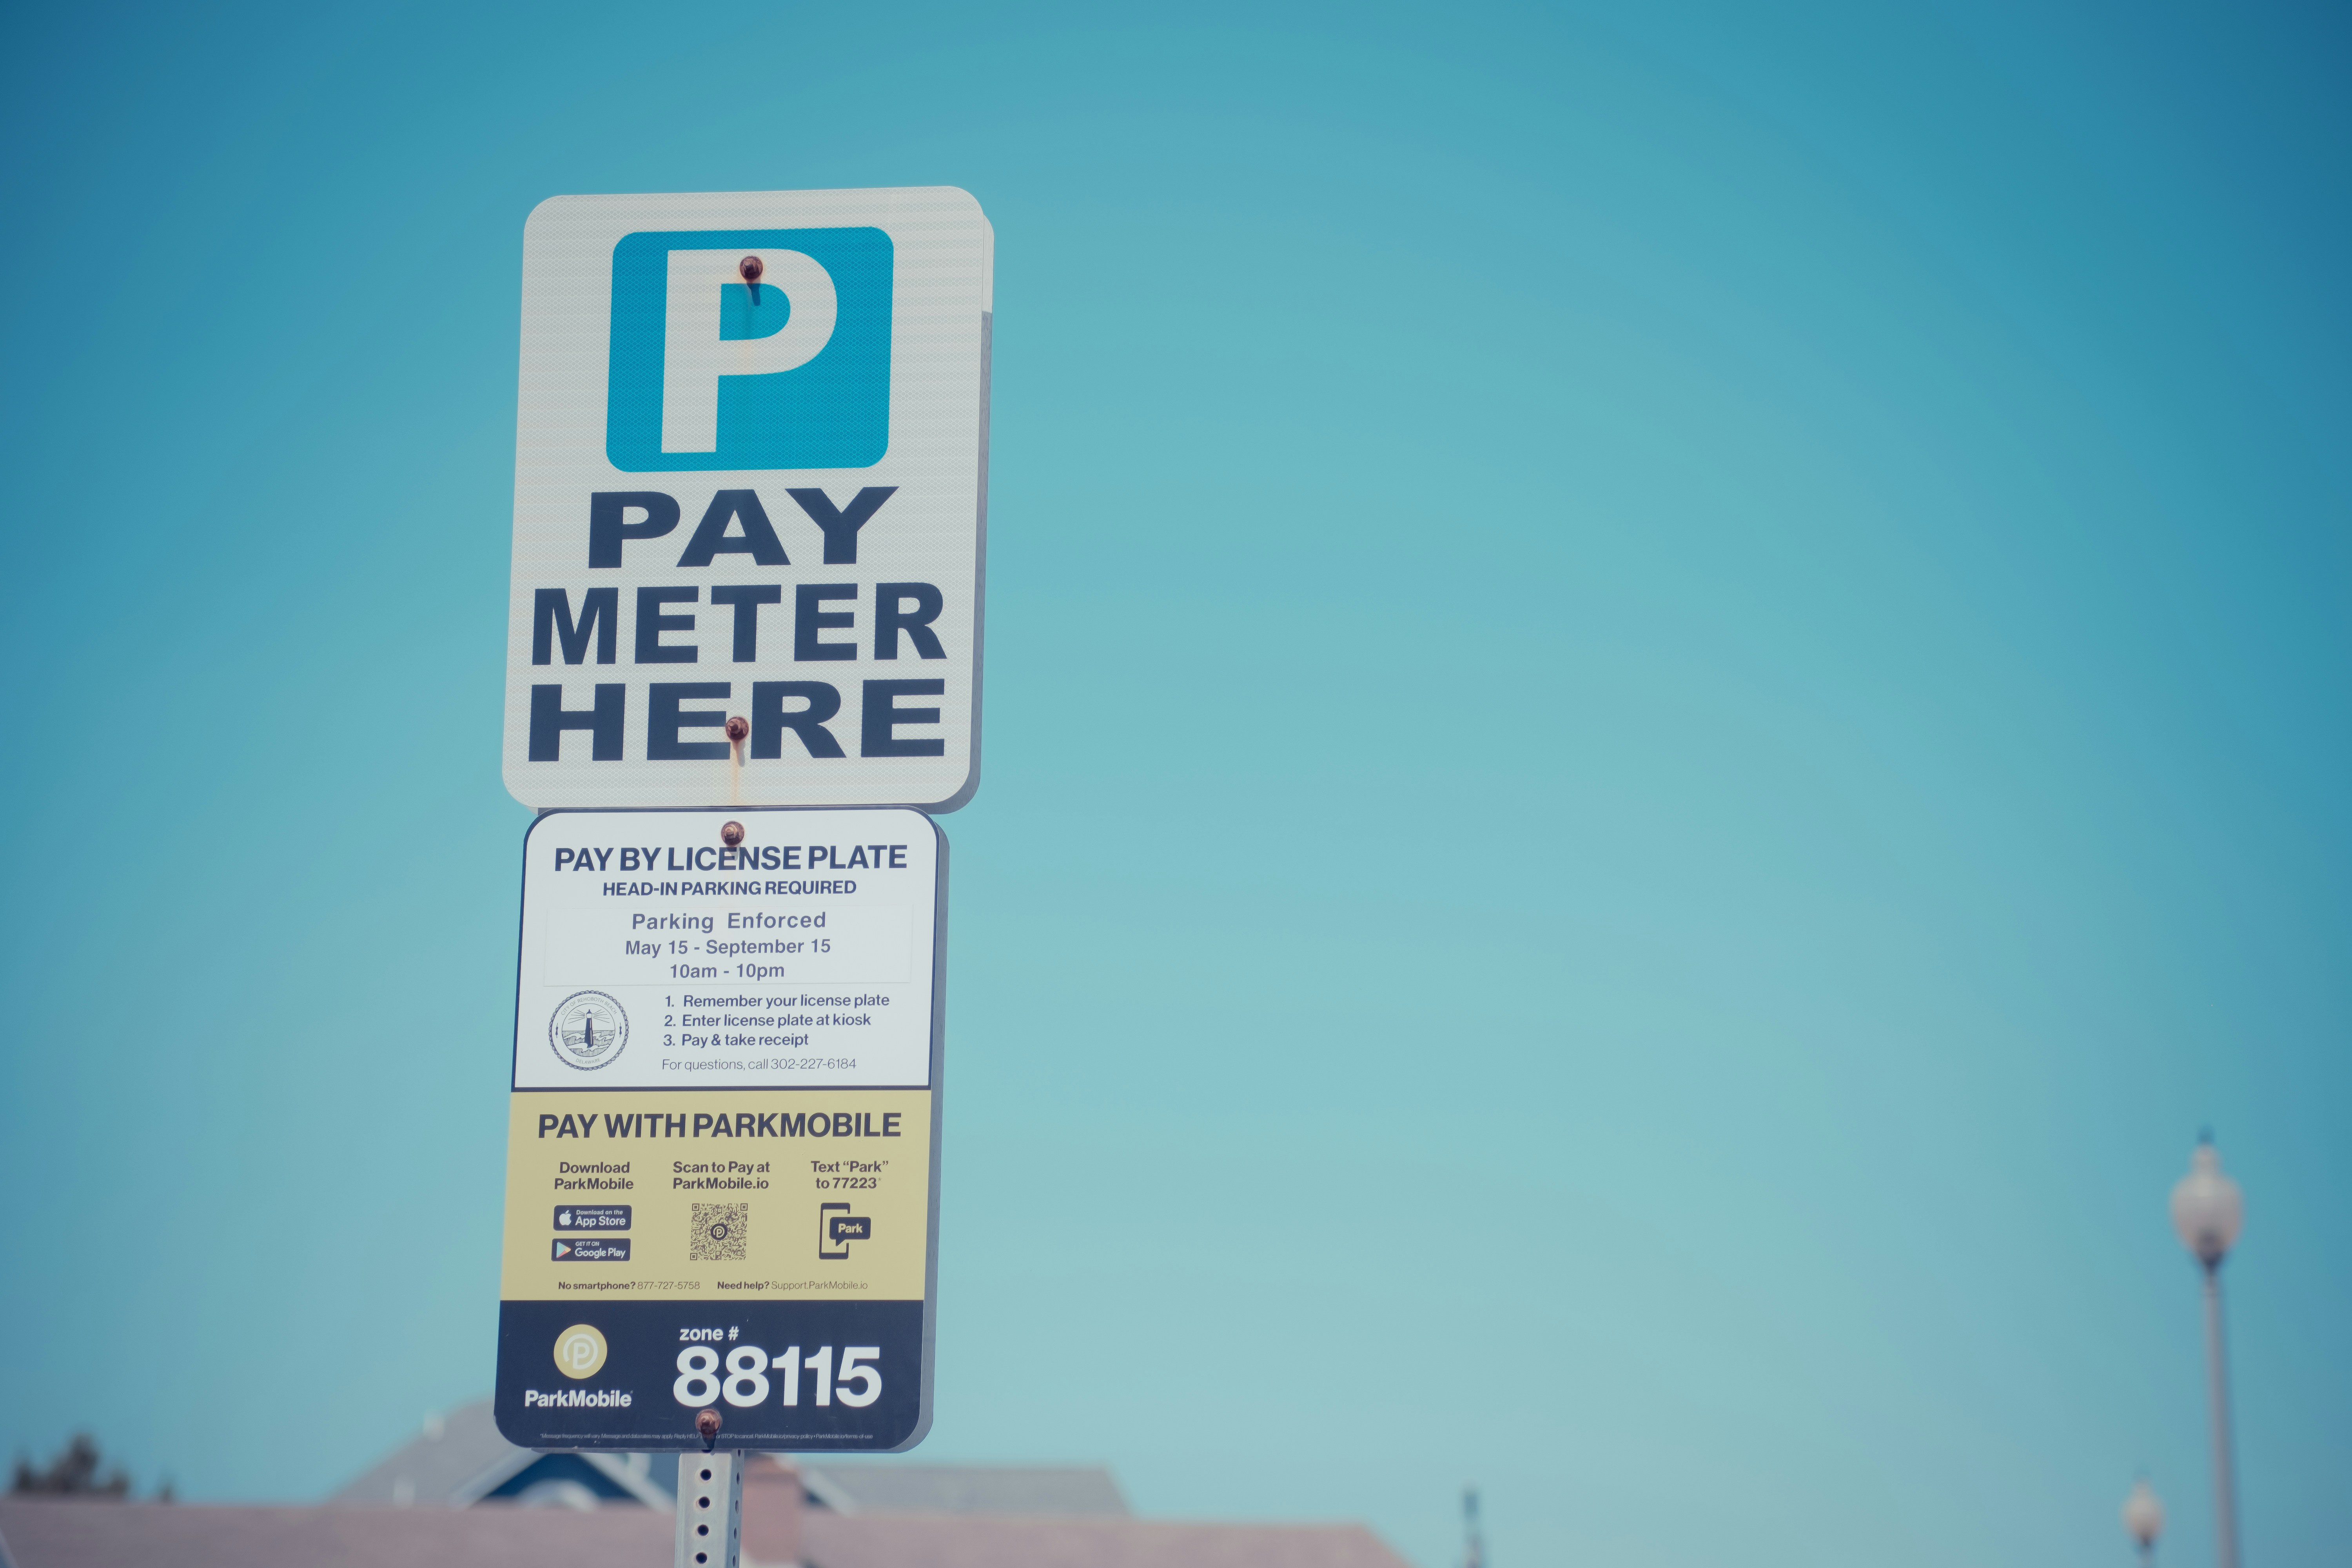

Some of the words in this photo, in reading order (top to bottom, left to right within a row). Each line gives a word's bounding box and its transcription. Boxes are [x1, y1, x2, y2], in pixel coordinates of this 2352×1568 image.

[661, 248, 838, 454] P
[588, 486, 899, 569] PAY
[532, 582, 947, 666] METER
[528, 678, 945, 762] HERE
[555, 848, 614, 871] PAY
[620, 847, 662, 871] BY
[668, 844, 802, 871] LICENSE
[808, 844, 907, 869] PLATE
[603, 882, 678, 896] HEAD-IN
[681, 881, 761, 896] PARKING
[765, 880, 857, 895] REQUIRED
[632, 913, 713, 934] Parking
[728, 911, 826, 929] Enforced
[626, 940, 662, 958] May
[668, 940, 688, 955] 15
[706, 939, 804, 958] September
[811, 938, 831, 953] 15
[670, 964, 717, 978] 10am
[736, 963, 784, 981] 10pm
[561, 1005, 570, 1015] CITY
[604, 1002, 618, 1014] BEACH
[665, 995, 674, 1007] 1.
[684, 995, 763, 1007] Remember
[766, 997, 798, 1009] your
[800, 994, 851, 1006] license
[854, 993, 889, 1009] plate
[664, 1014, 676, 1027] 2.
[682, 1014, 721, 1027] Enter
[724, 1014, 775, 1026] license
[778, 1013, 813, 1029] plate
[816, 1014, 830, 1026] at
[833, 1013, 871, 1025] kiosk
[663, 1034, 675, 1046] 3.
[682, 1034, 708, 1049] Pay
[711, 1034, 721, 1046] &
[724, 1033, 756, 1046] take
[759, 1033, 809, 1048] receipt
[662, 1059, 682, 1070] For
[684, 1058, 745, 1072] questions,
[748, 1058, 768, 1069] call
[771, 1058, 857, 1069] 302-227-6184
[538, 1114, 598, 1138] PAY
[604, 1113, 686, 1138] WITH
[693, 1112, 902, 1138] PARKMOBILE
[559, 1161, 630, 1174] Download
[673, 1161, 709, 1173] Scan
[711, 1161, 725, 1173] to
[728, 1161, 754, 1176] Pay
[757, 1161, 770, 1173] at
[810, 1160, 840, 1172] Text
[843, 1160, 889, 1172] “Park”
[554, 1178, 634, 1190] ParkMobile
[673, 1177, 769, 1189] ParkMobile.io
[815, 1178, 830, 1189] to
[575, 1216, 597, 1228] App
[598, 1216, 626, 1226] Store
[838, 1223, 863, 1233] Park
[575, 1247, 607, 1259] Google
[608, 1247, 626, 1259] Play
[558, 1281, 572, 1290] No
[573, 1281, 636, 1291] smartphone?
[637, 1281, 700, 1290] 877-727-5758
[717, 1281, 742, 1290] Need
[743, 1281, 770, 1291] help?
[771, 1281, 868, 1291] Support.ParkMobile.io
[679, 1328, 724, 1341] zone
[728, 1326, 739, 1341] #
[673, 1345, 882, 1407] 88115
